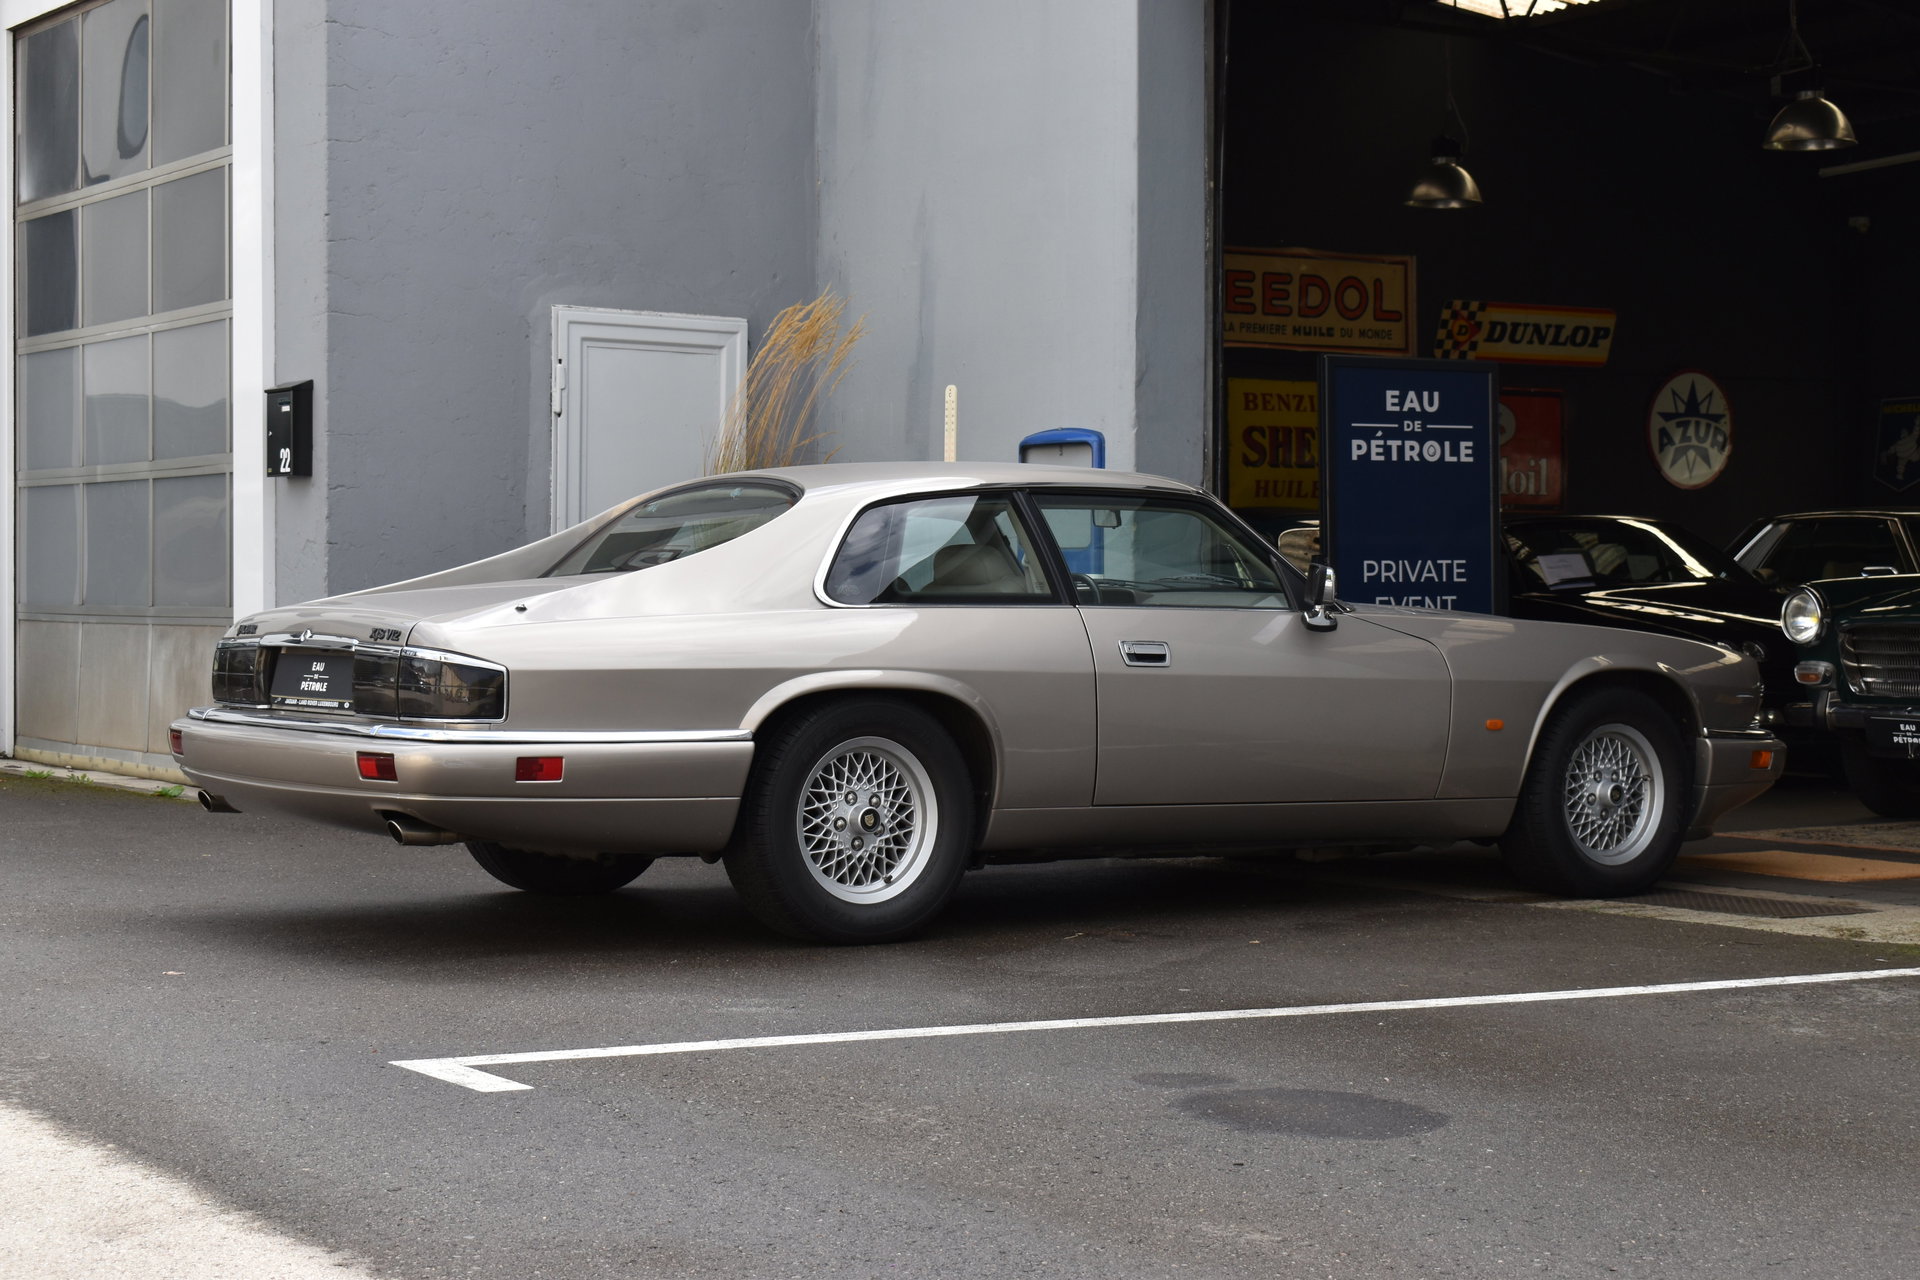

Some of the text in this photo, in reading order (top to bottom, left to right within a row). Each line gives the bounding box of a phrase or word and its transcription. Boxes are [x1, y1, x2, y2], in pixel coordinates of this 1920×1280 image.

[1224, 269, 1402, 323] EEDOL
[1292, 325, 1335, 337] HUILE
[1340, 327, 1354, 338] DU
[1360, 328, 1394, 340] MONDE
[1455, 320, 1611, 348] D DUNLOP
[1242, 391, 1317, 413] BENZI
[1385, 389, 1440, 413] EAU
[1403, 420, 1423, 432] DE
[1658, 419, 1728, 455] AZUR
[1241, 425, 1319, 469] SHE
[1351, 430, 1474, 463] PÉTROLE
[279, 447, 291, 473] 22
[1363, 559, 1467, 583] PRIVATE
[385, 629, 402, 642] V12
[311, 661, 326, 672] EAU
[300, 678, 328, 692] PÉTROLE
[1899, 723, 1916, 732] EAU
